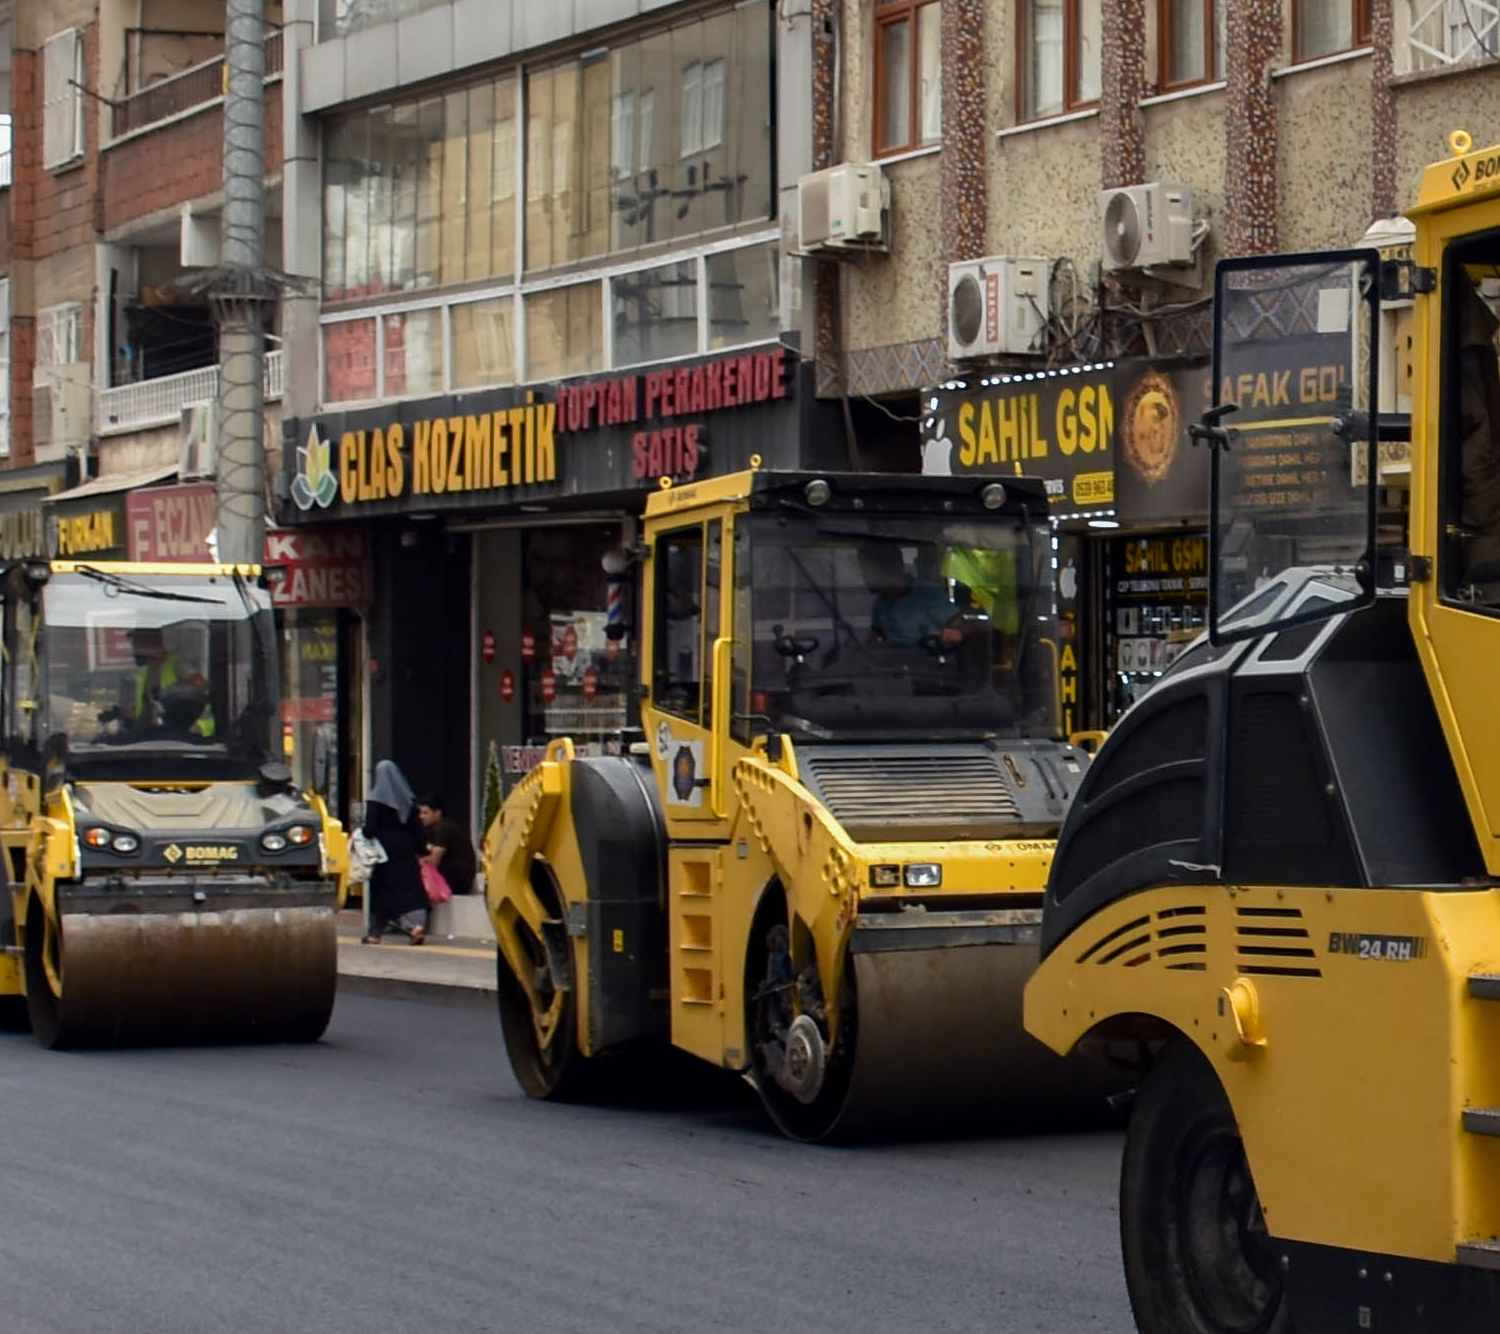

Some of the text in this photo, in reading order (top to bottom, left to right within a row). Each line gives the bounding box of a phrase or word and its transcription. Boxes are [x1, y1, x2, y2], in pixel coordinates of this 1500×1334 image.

[646, 347, 787, 419] PERAKENDE
[340, 391, 557, 504] CLAS KOZMETİK
[632, 424, 700, 481] SATIŞ
[185, 845, 238, 860] BOMAG
